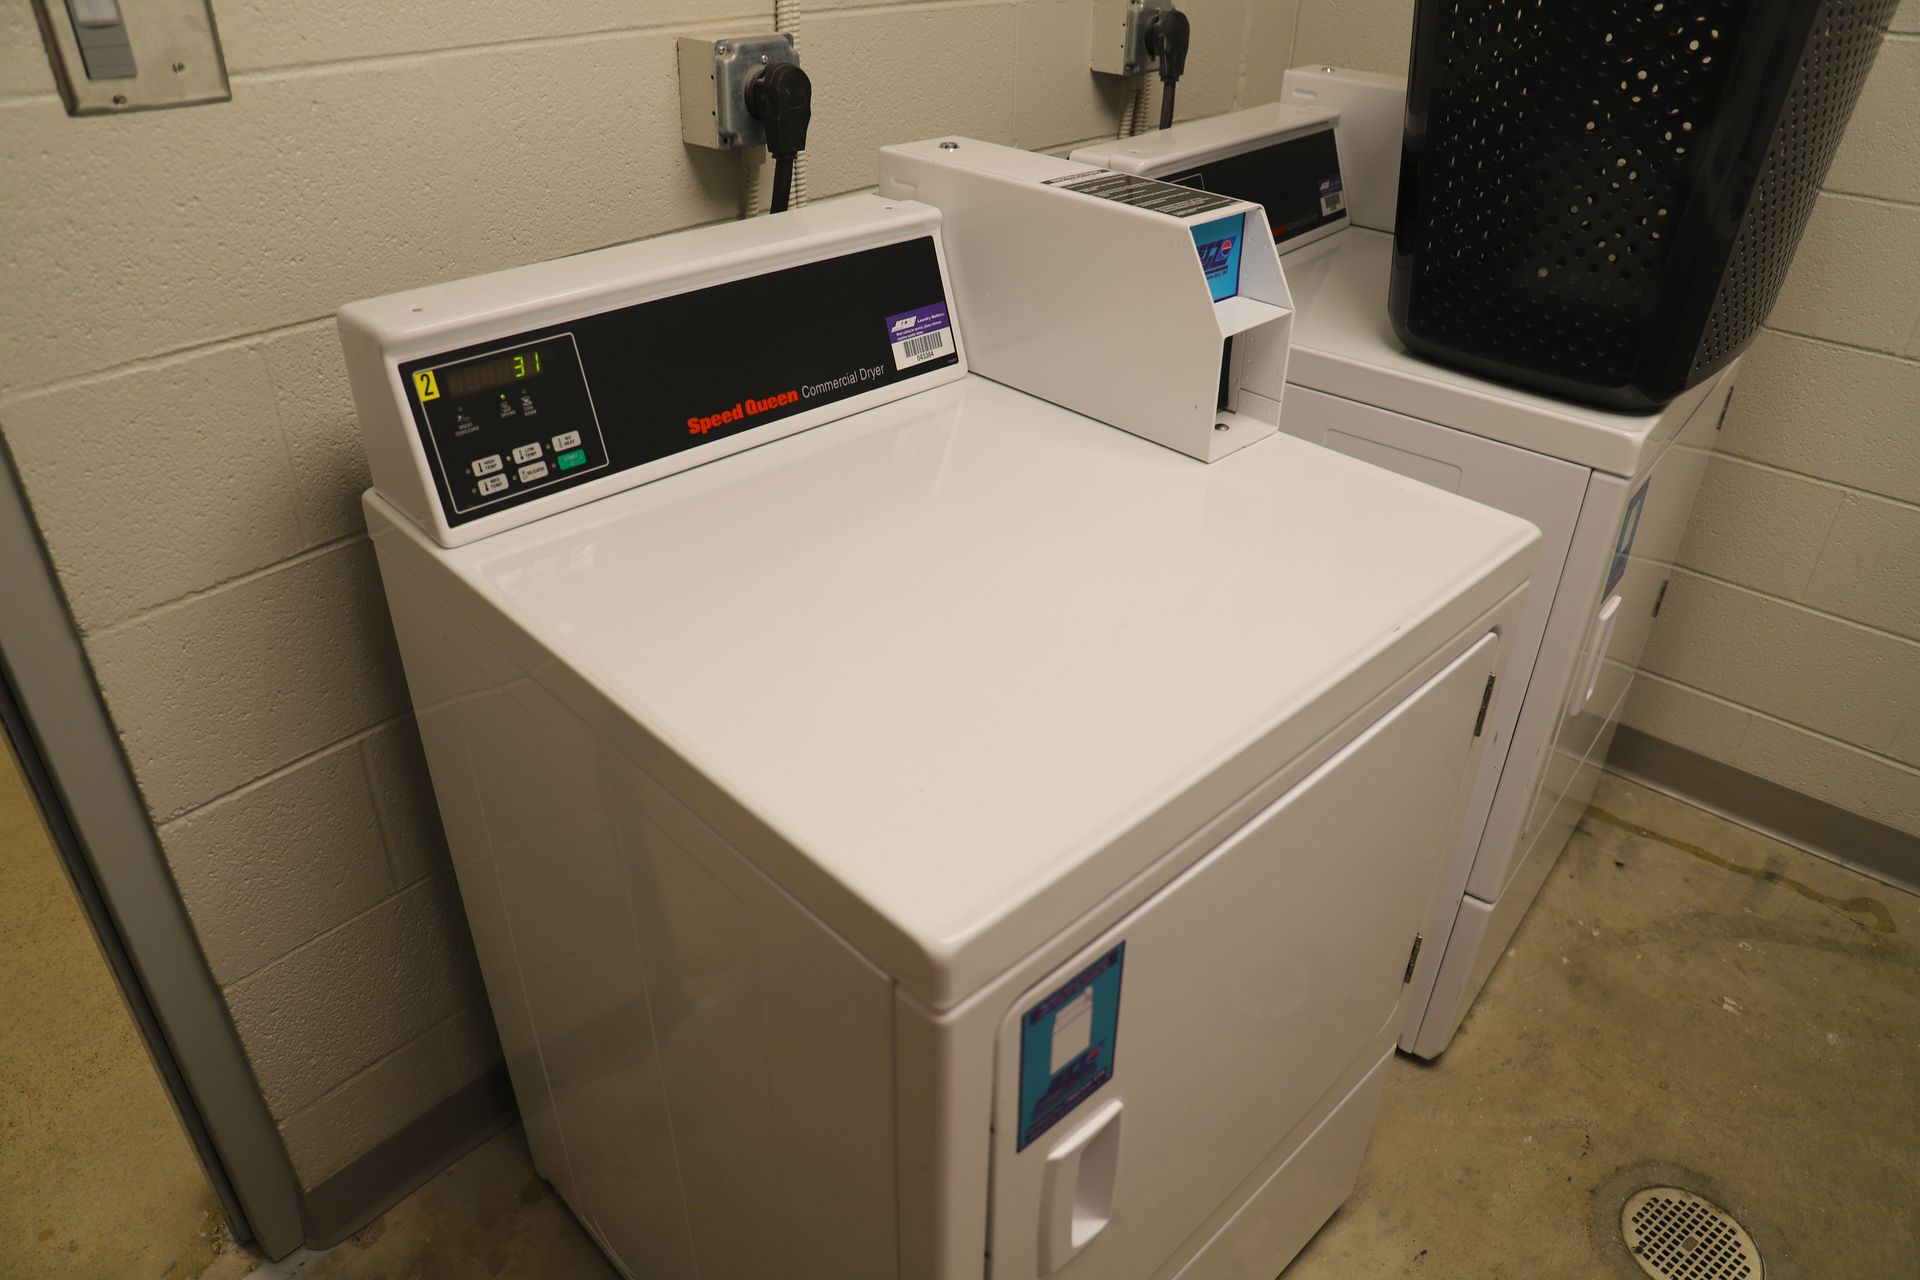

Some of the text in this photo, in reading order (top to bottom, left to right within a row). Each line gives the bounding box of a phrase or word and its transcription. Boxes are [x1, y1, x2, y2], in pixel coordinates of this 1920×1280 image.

[917, 351, 934, 361] 043384
[513, 351, 540, 379] 31
[420, 373, 434, 397] 2
[687, 363, 885, 435] Speed Queen Commercial Dryer
[524, 446, 535, 454] LOW
[485, 463, 497, 471] TEMP
